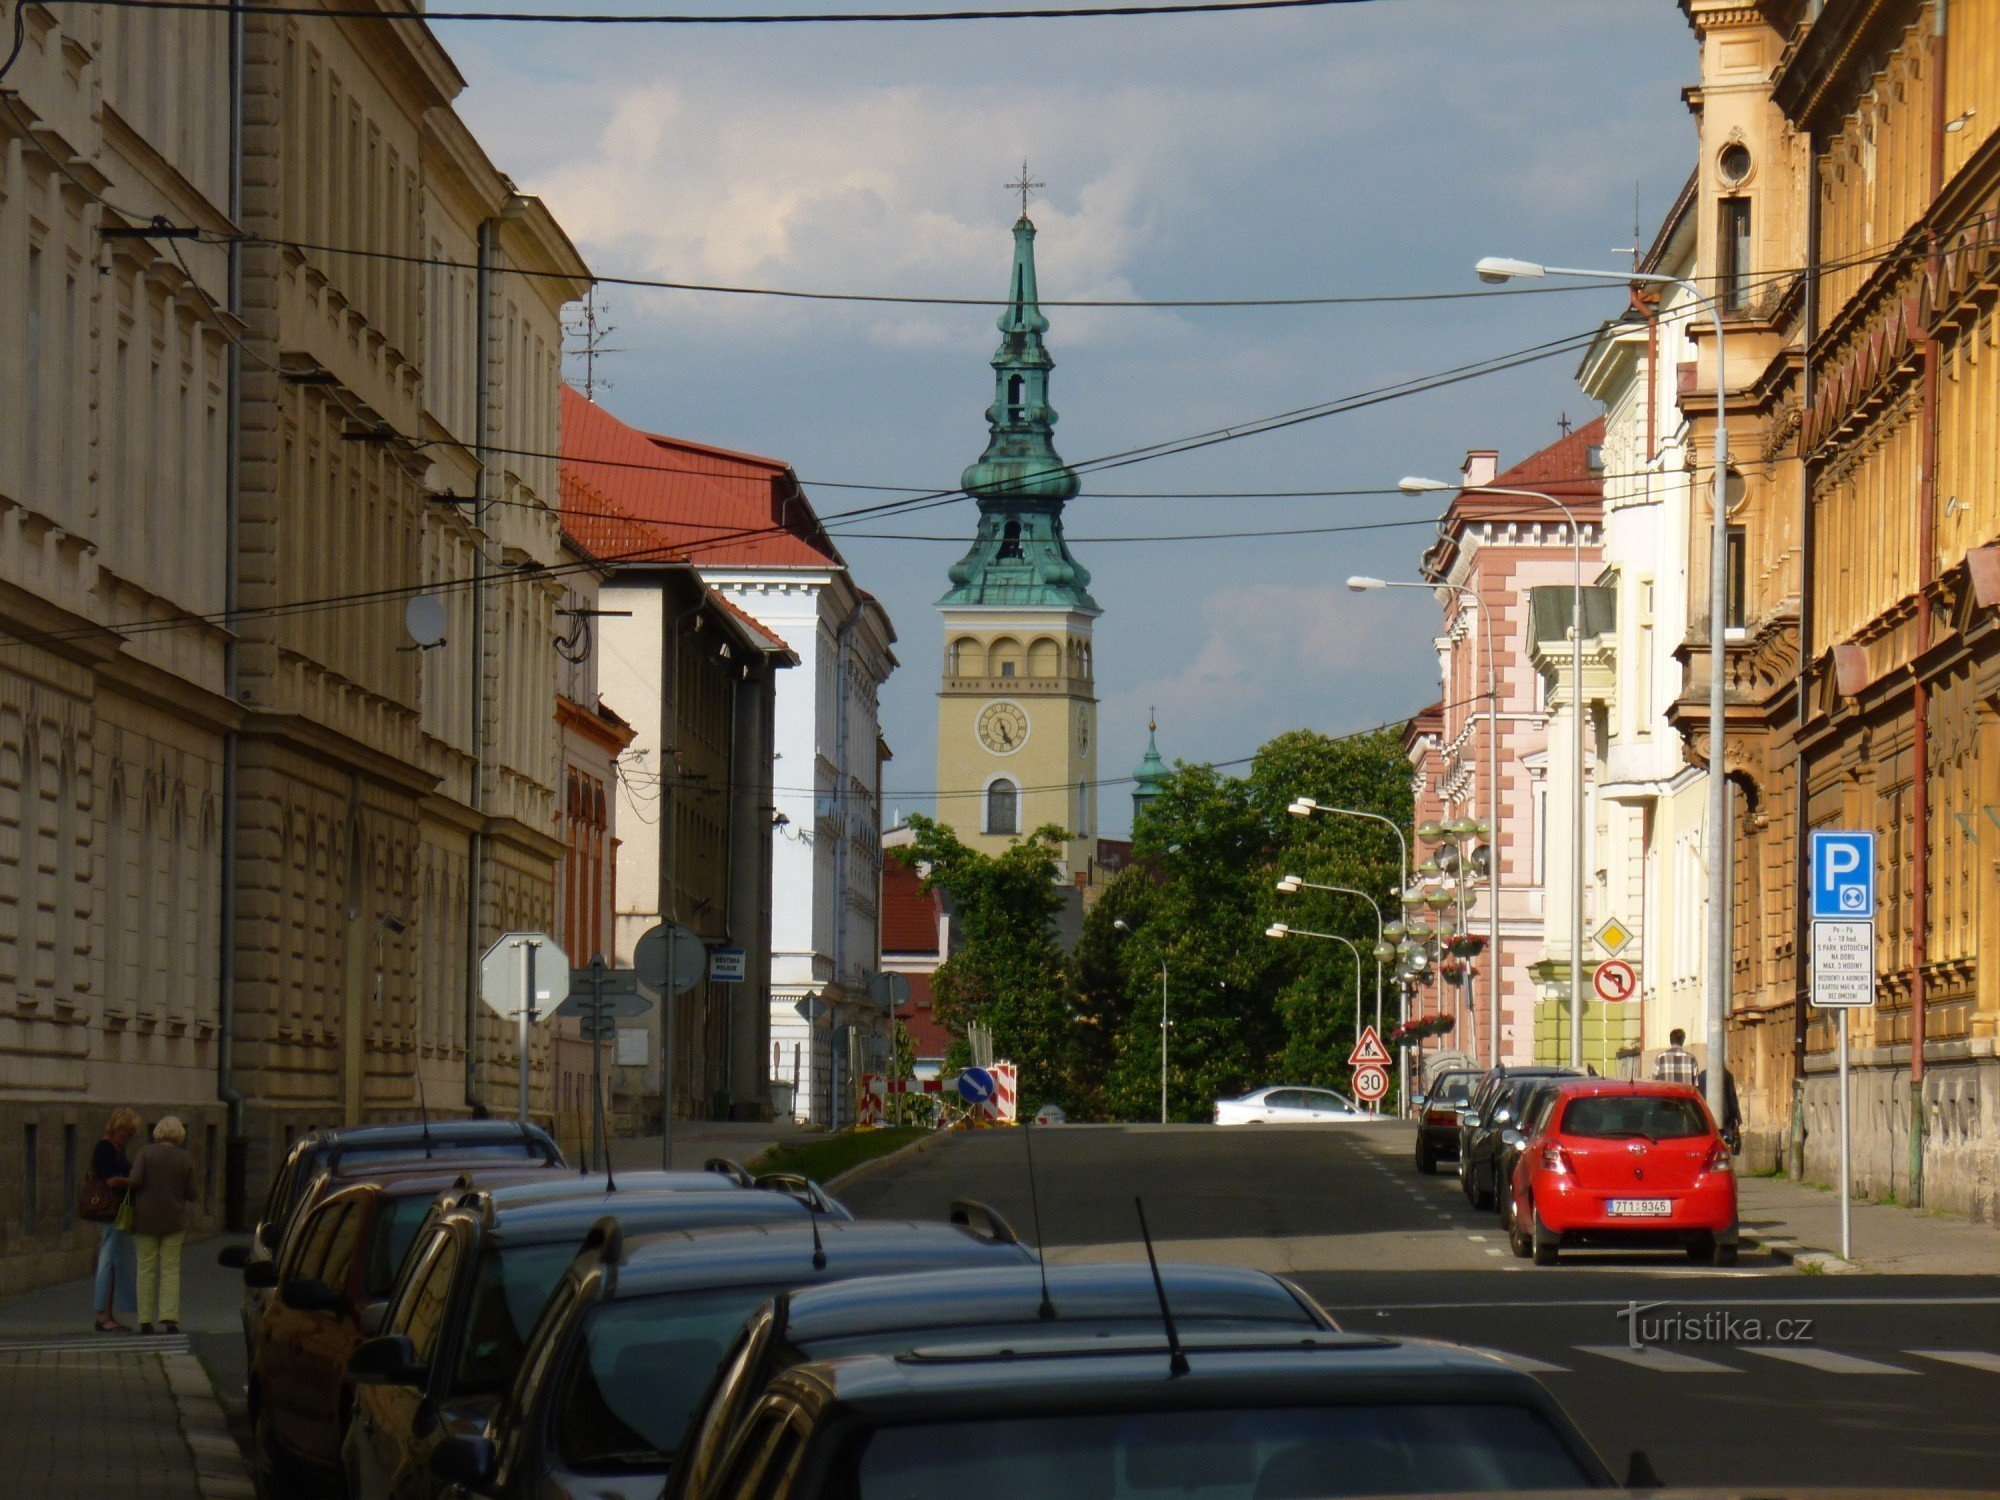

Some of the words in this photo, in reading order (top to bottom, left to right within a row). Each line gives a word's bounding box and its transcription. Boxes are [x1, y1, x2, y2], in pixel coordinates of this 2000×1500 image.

[1826, 844, 1860, 890] P
[1361, 1075, 1380, 1090] 30
[1616, 1202, 1633, 1211] 7T1
[1642, 1202, 1666, 1211] 9345
